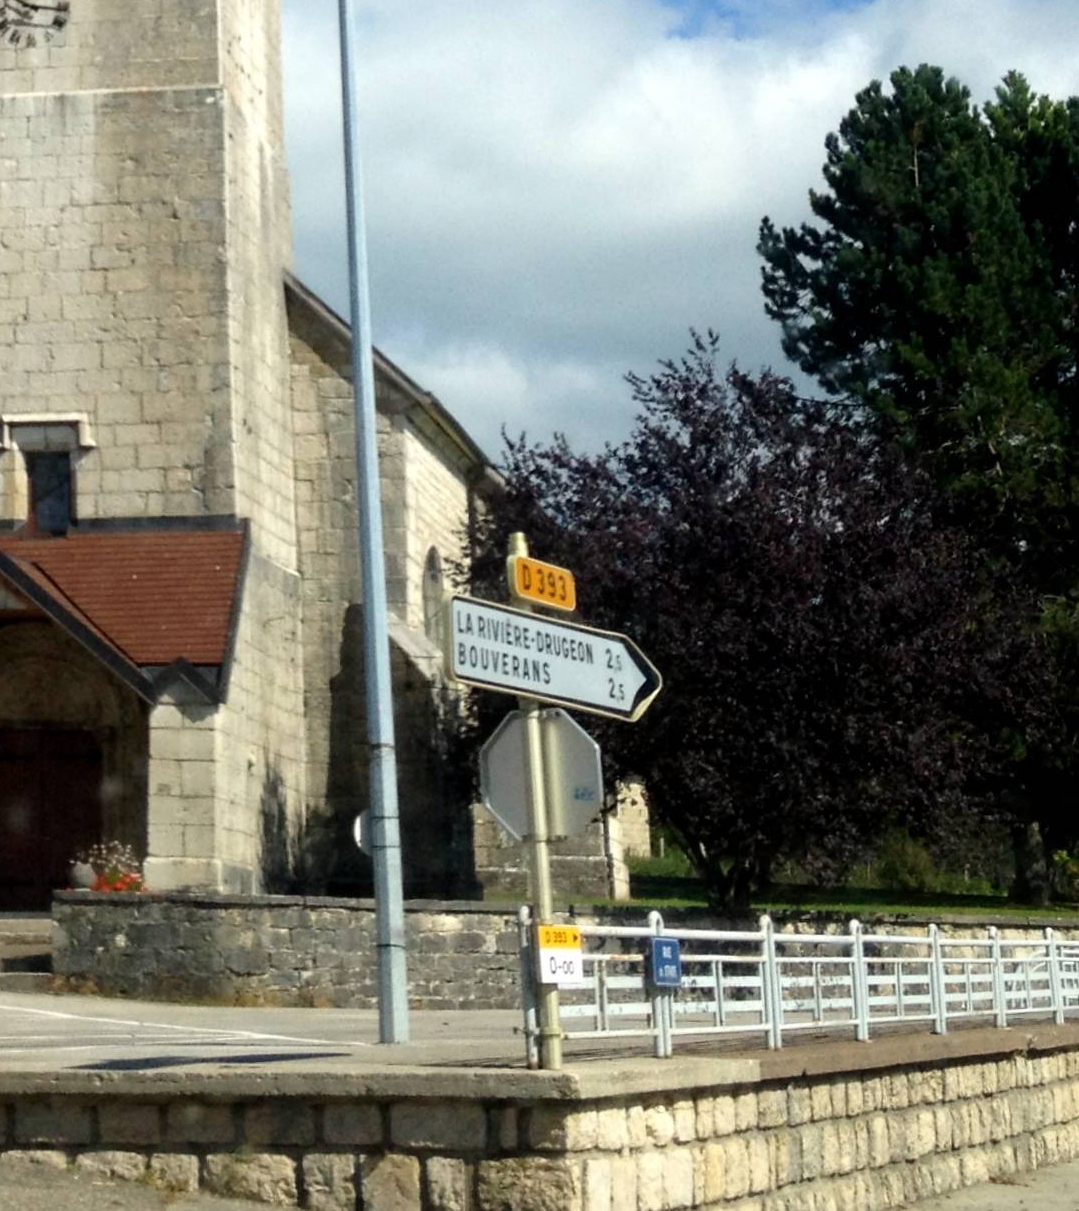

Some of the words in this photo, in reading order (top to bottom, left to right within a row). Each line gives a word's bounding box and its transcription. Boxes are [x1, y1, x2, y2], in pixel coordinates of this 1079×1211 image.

[522, 564, 532, 591] D
[537, 569, 567, 601] 393
[457, 611, 474, 637] LA
[478, 615, 594, 664] RIVIÈRE-DRUGEON
[458, 642, 551, 684] BOUVERANS
